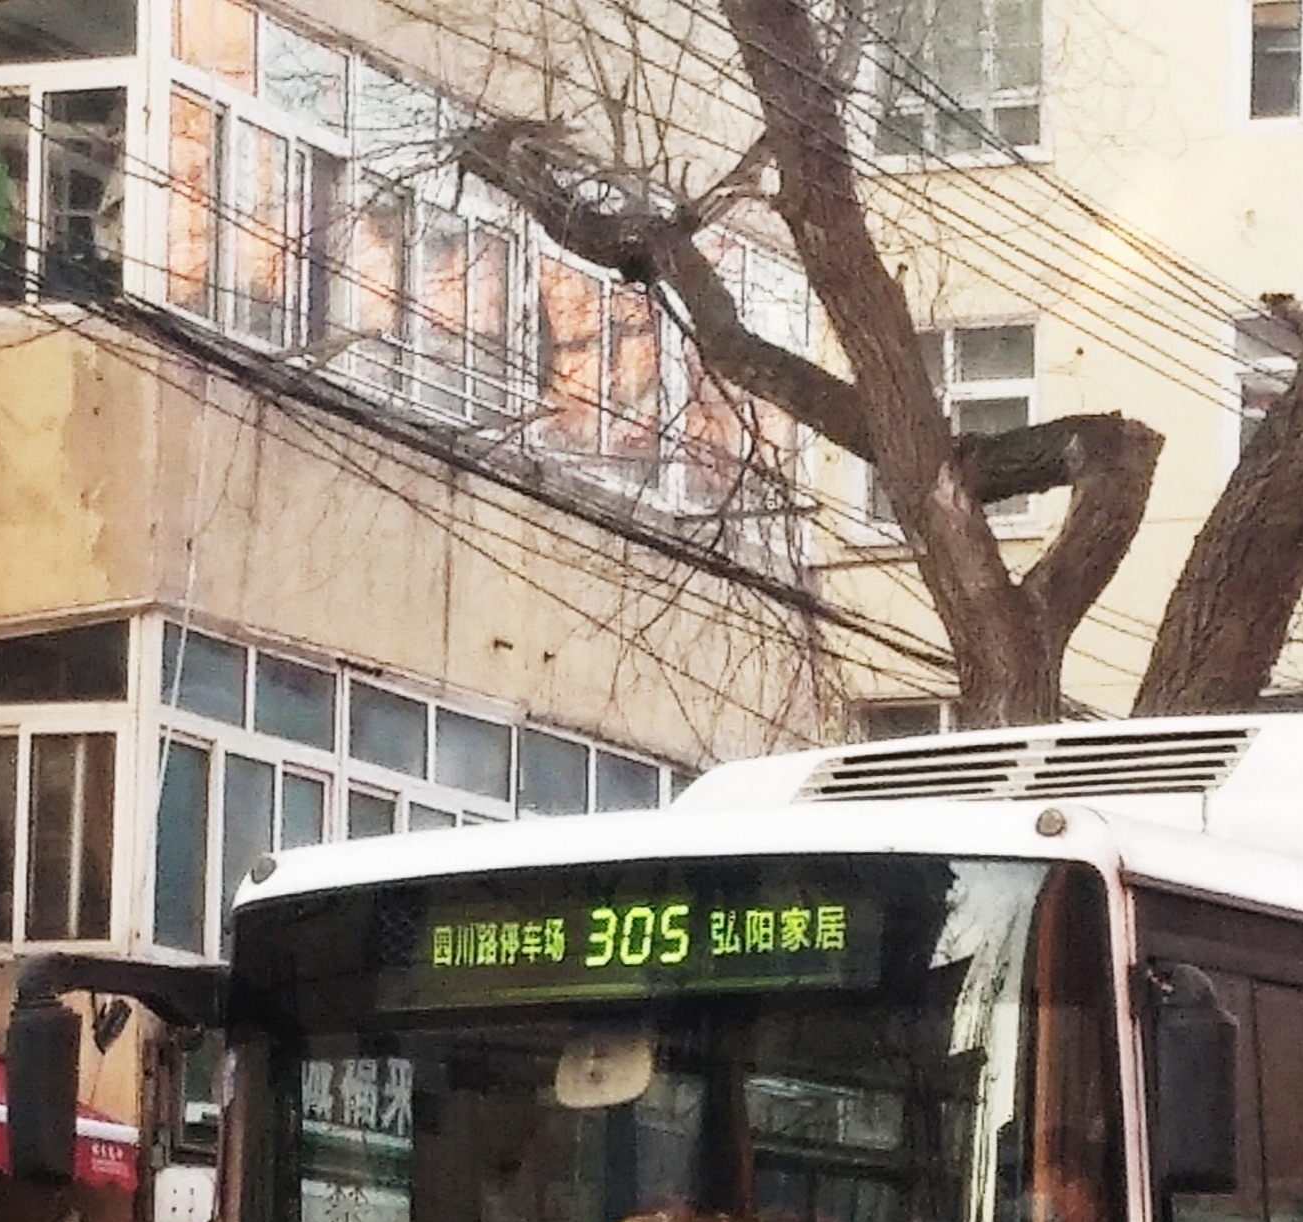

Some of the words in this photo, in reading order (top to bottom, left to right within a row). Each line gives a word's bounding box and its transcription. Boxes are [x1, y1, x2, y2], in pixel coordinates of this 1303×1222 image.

[432, 917, 566, 970] 四川路停车场
[584, 904, 691, 968] 305
[710, 904, 847, 956] 弘阳家居
